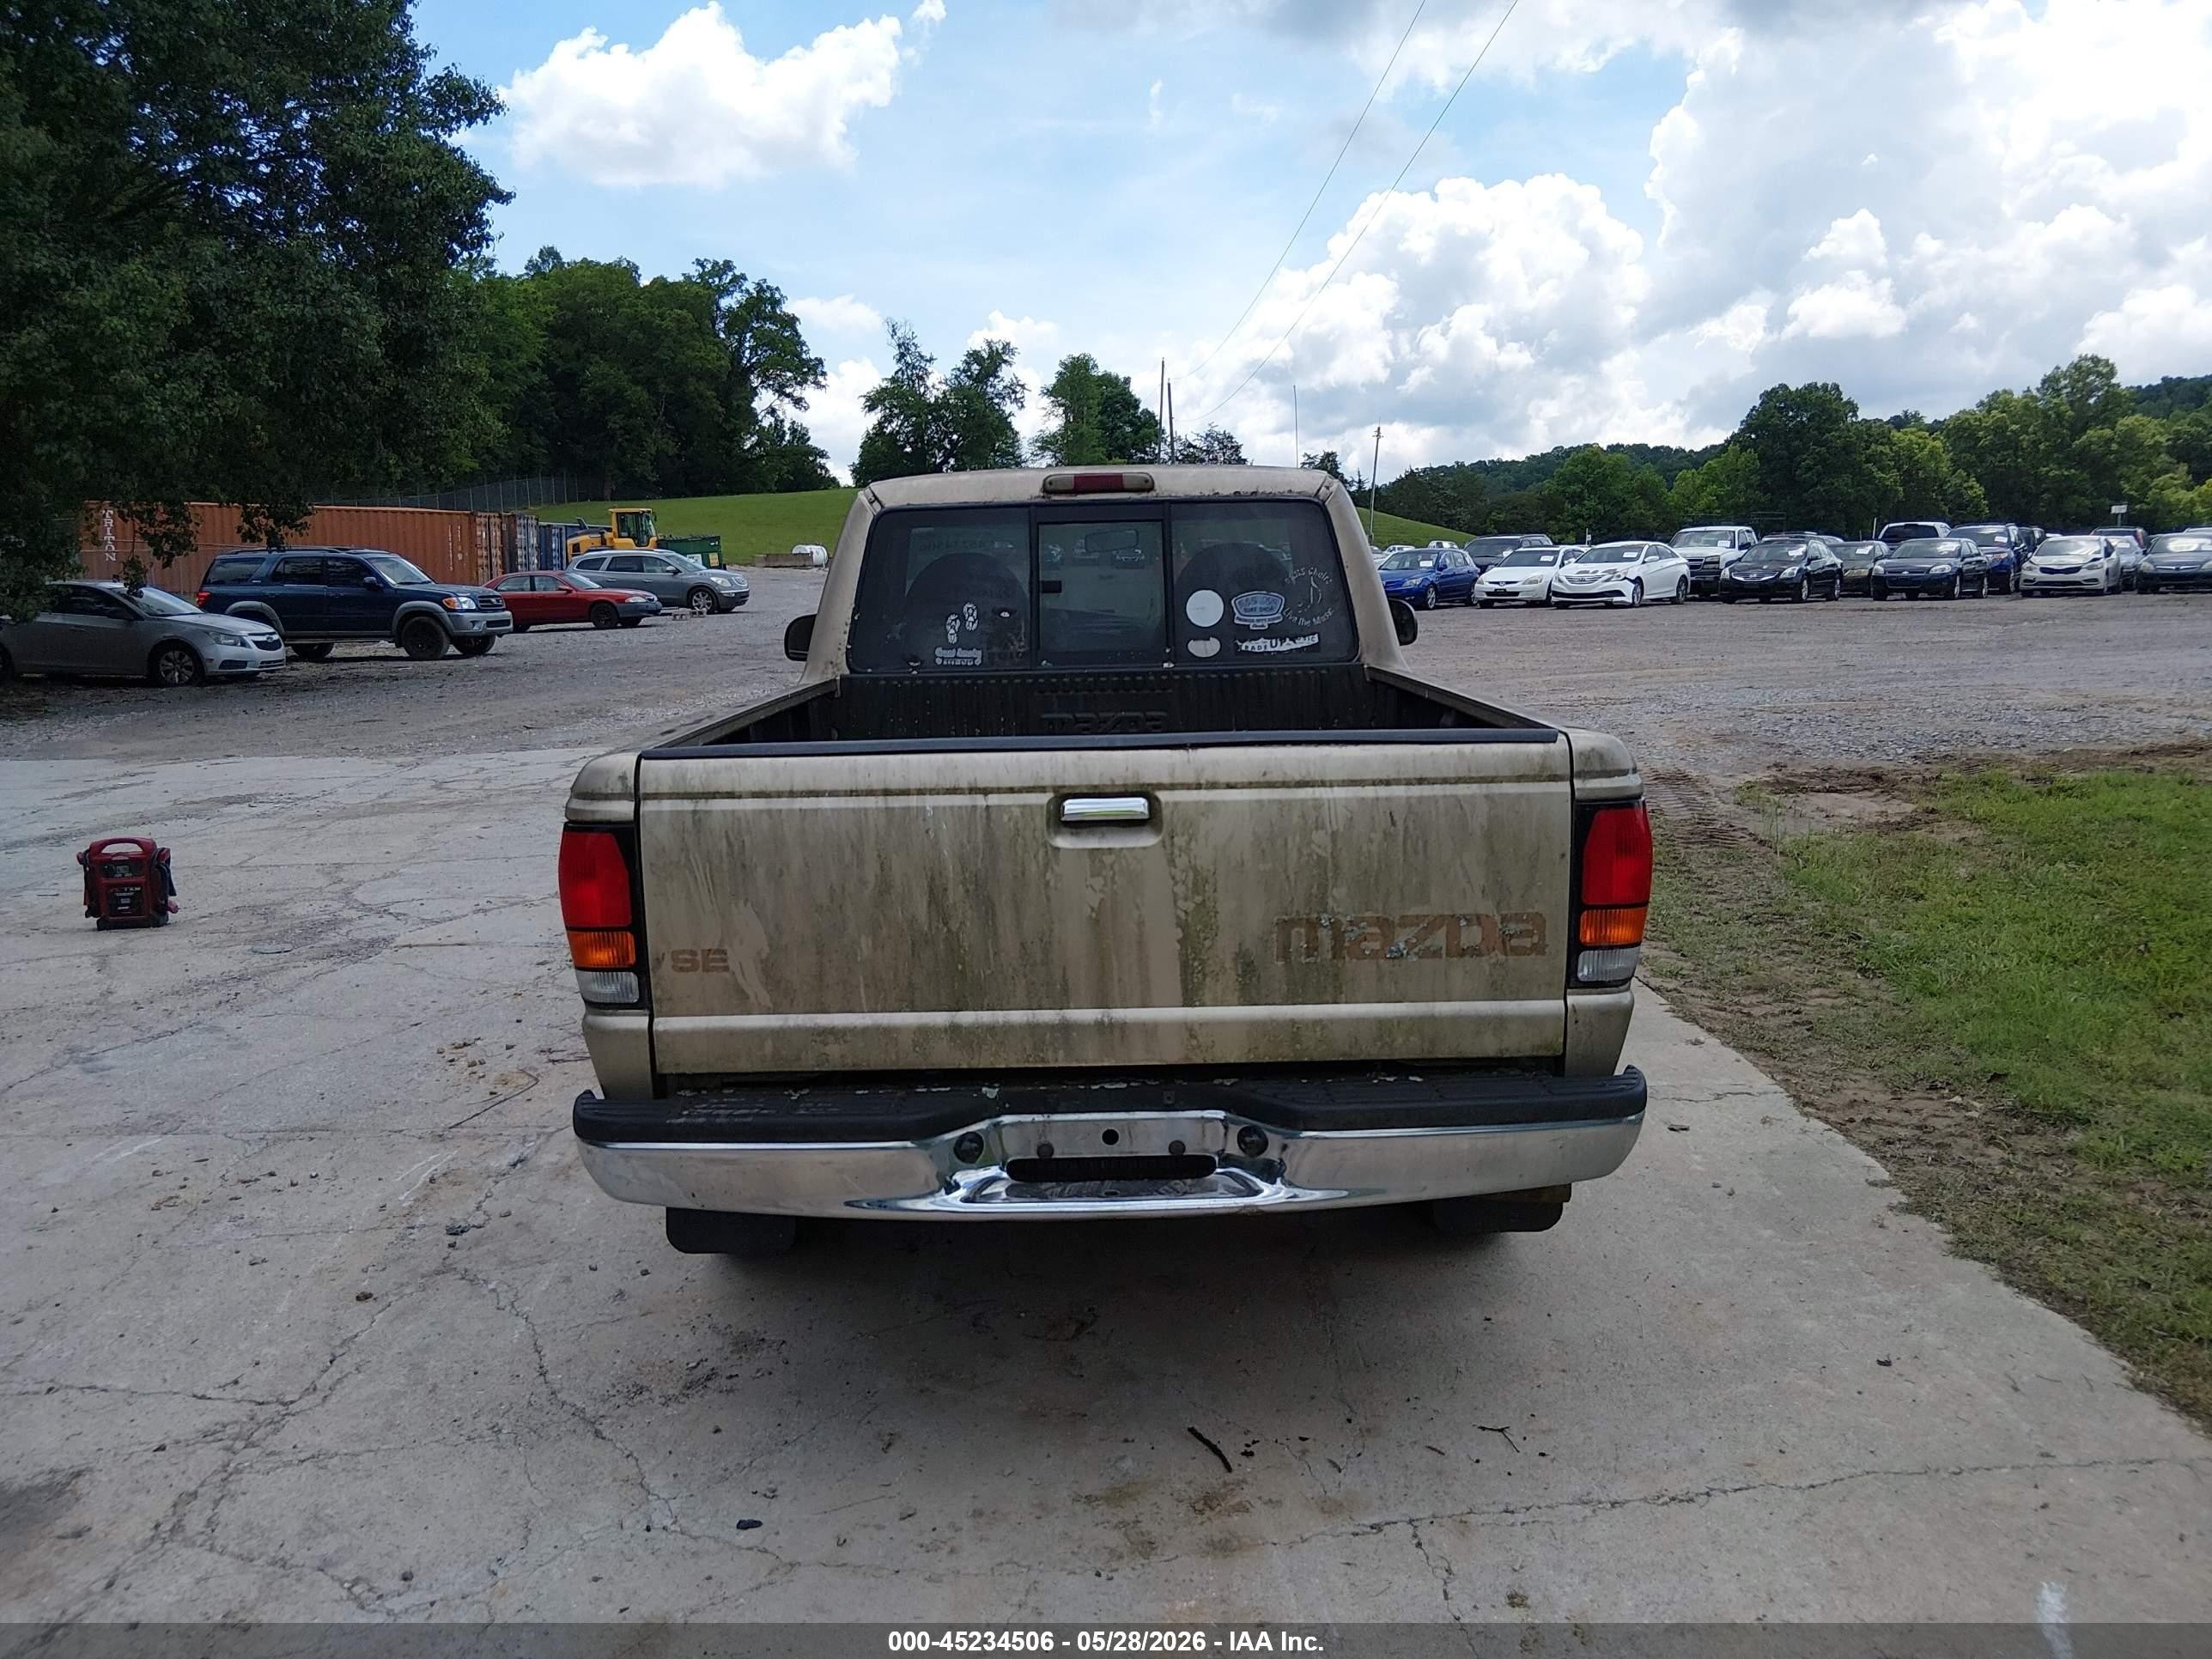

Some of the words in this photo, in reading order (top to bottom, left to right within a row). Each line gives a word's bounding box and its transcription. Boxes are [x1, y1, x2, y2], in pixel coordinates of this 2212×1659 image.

[103, 510, 116, 561] TRITON
[671, 948, 730, 972] SE
[1275, 912, 1547, 962] mazda
